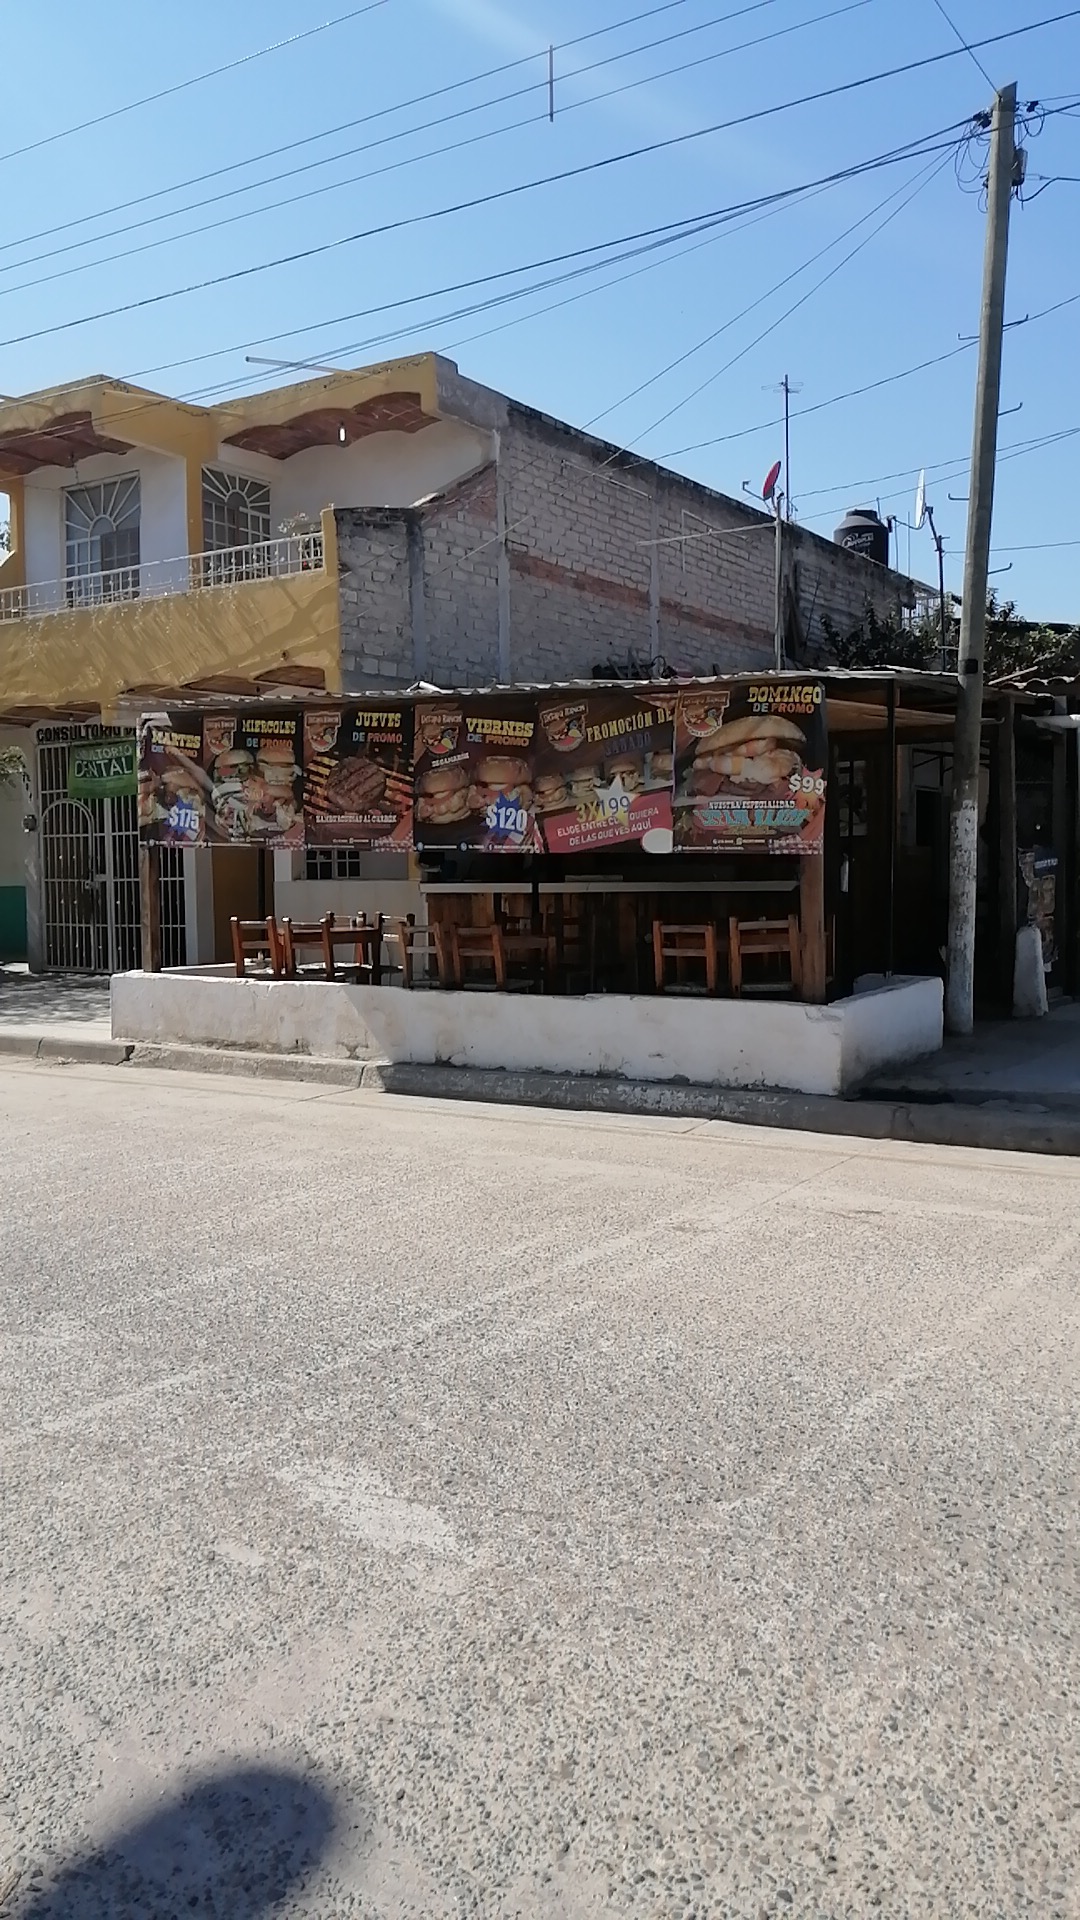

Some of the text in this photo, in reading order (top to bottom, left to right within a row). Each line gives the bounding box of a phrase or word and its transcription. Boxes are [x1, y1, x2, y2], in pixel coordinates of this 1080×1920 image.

[747, 686, 822, 704] DOMINGO
[753, 703, 815, 714] DE PROMO
[355, 712, 402, 728] JUEVES
[465, 717, 535, 738] VIERNES
[586, 711, 653, 743] PROMOCIÓN
[36, 723, 120, 742] CONSULTORIO
[151, 730, 201, 749] MARTES
[352, 732, 403, 743] DE PROMO
[467, 733, 530, 747] DE PROMO
[246, 738, 294, 750] DE PROMO
[75, 757, 133, 778] DENTAL
[788, 773, 825, 795] $99
[168, 806, 200, 829] $175
[485, 805, 528, 832] $120
[557, 824, 581, 838] ELIGE
[569, 836, 581, 847] DE
[581, 832, 597, 844] LAS
[598, 829, 614, 840] QUE
